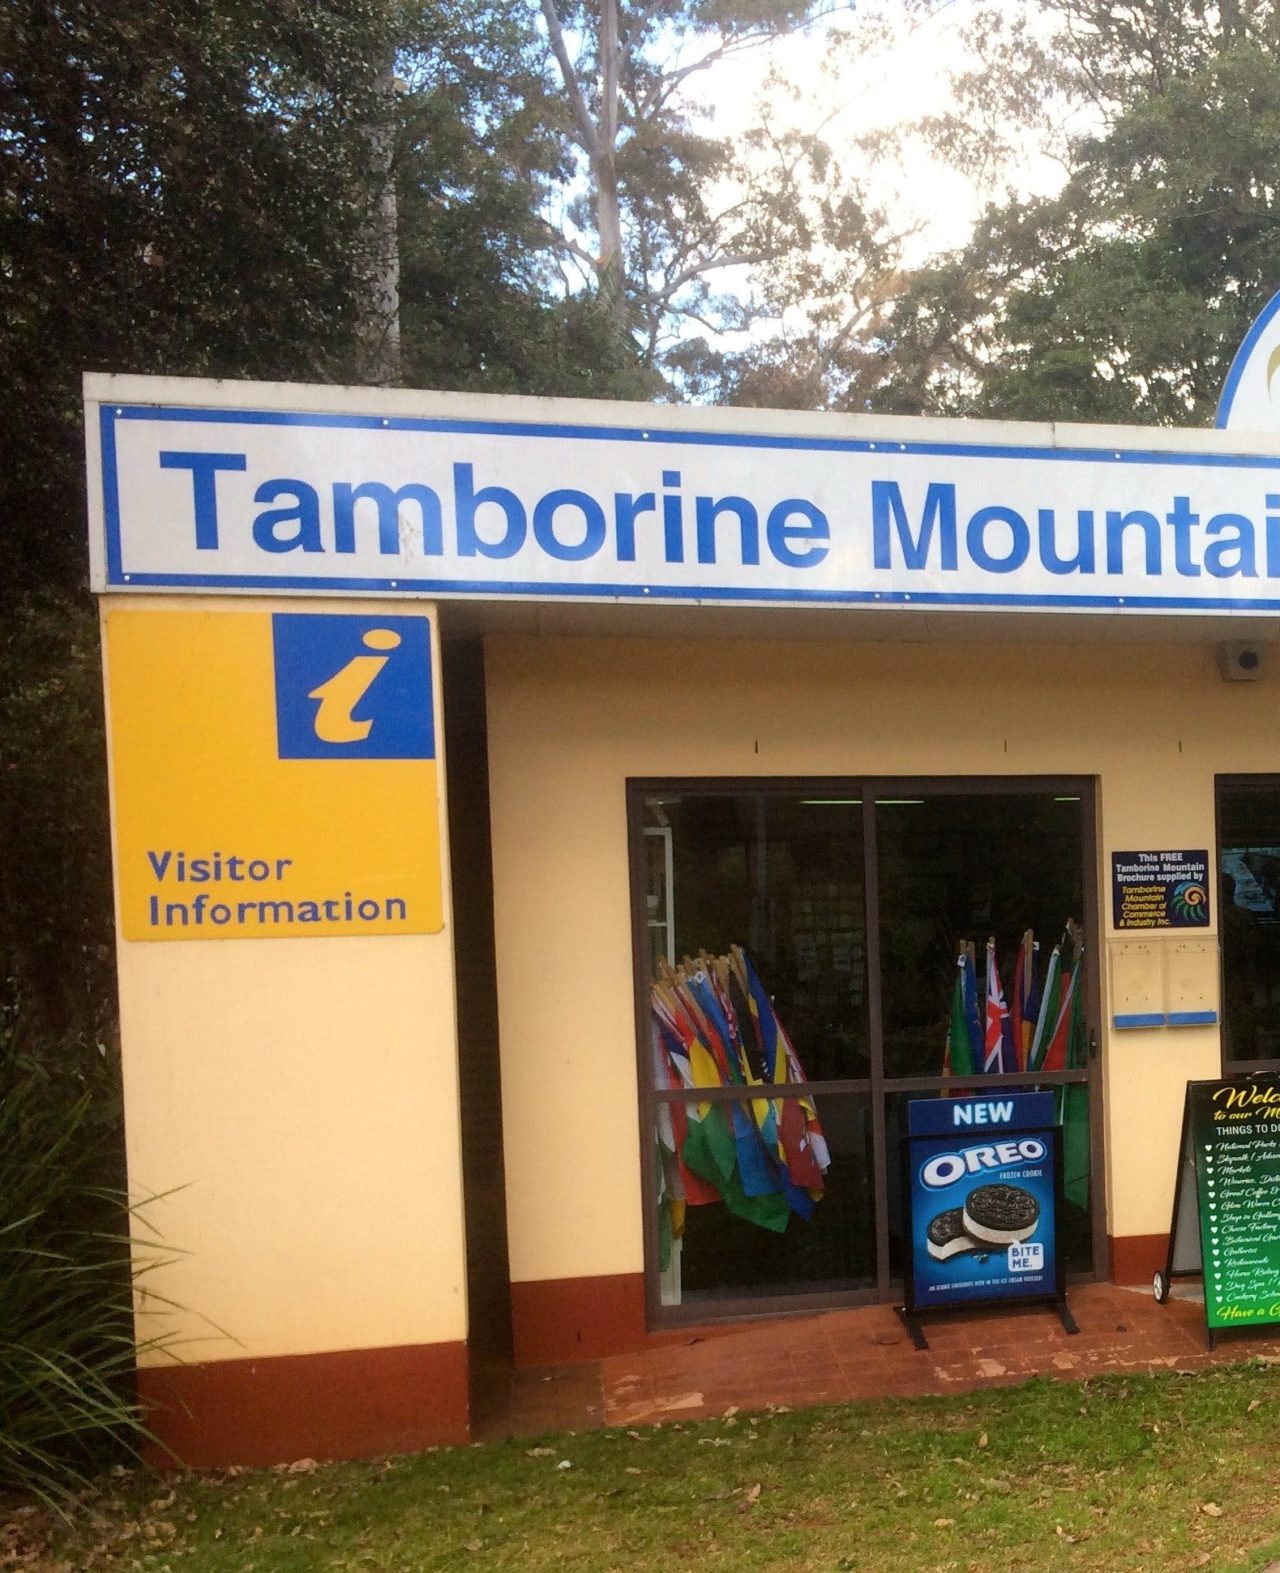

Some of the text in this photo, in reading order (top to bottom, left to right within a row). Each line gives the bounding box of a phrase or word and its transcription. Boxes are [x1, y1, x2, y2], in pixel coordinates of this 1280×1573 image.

[159, 450, 831, 568] Tamborine
[1138, 853, 1184, 862] This FREE
[147, 851, 293, 882] Visitor
[1116, 862, 1205, 873] Tamborine Mountain
[1117, 871, 1203, 882] Brochure supplied by
[1122, 885, 1167, 894] Tamborine
[1124, 894, 1165, 902] Mountain
[150, 891, 408, 927] Information
[1121, 902, 1158, 910] Chamber
[1122, 910, 1166, 919] Commerce
[1126, 918, 1156, 927] Industry
[953, 1101, 1014, 1126] NEW
[1214, 1109, 1227, 1121] to
[1229, 1111, 1252, 1120] our
[1216, 1125, 1253, 1136] THINGS
[1255, 1124, 1269, 1134] TO
[1215, 1141, 1252, 1151] National
[1252, 1140, 1277, 1149] Parks
[922, 1140, 1044, 1187] OREO
[999, 1169, 1043, 1180] FROZEN COOKIE
[1217, 1165, 1252, 1175] Markets
[1220, 1188, 1246, 1199] Great
[1245, 1187, 1268, 1198] Coffee
[1220, 1201, 1242, 1211] Glow
[1242, 1199, 1270, 1209] Worm
[1221, 1222, 1278, 1234] Cheese Factory
[1222, 1234, 1262, 1245] Botanical
[1011, 1245, 1040, 1258] BITE
[1011, 1257, 1033, 1269] ME.
[1225, 1267, 1280, 1279] Horse Riding
[1225, 1281, 1246, 1291] Day
[1247, 1279, 1265, 1290] Spa
[1216, 1304, 1255, 1320] Have
